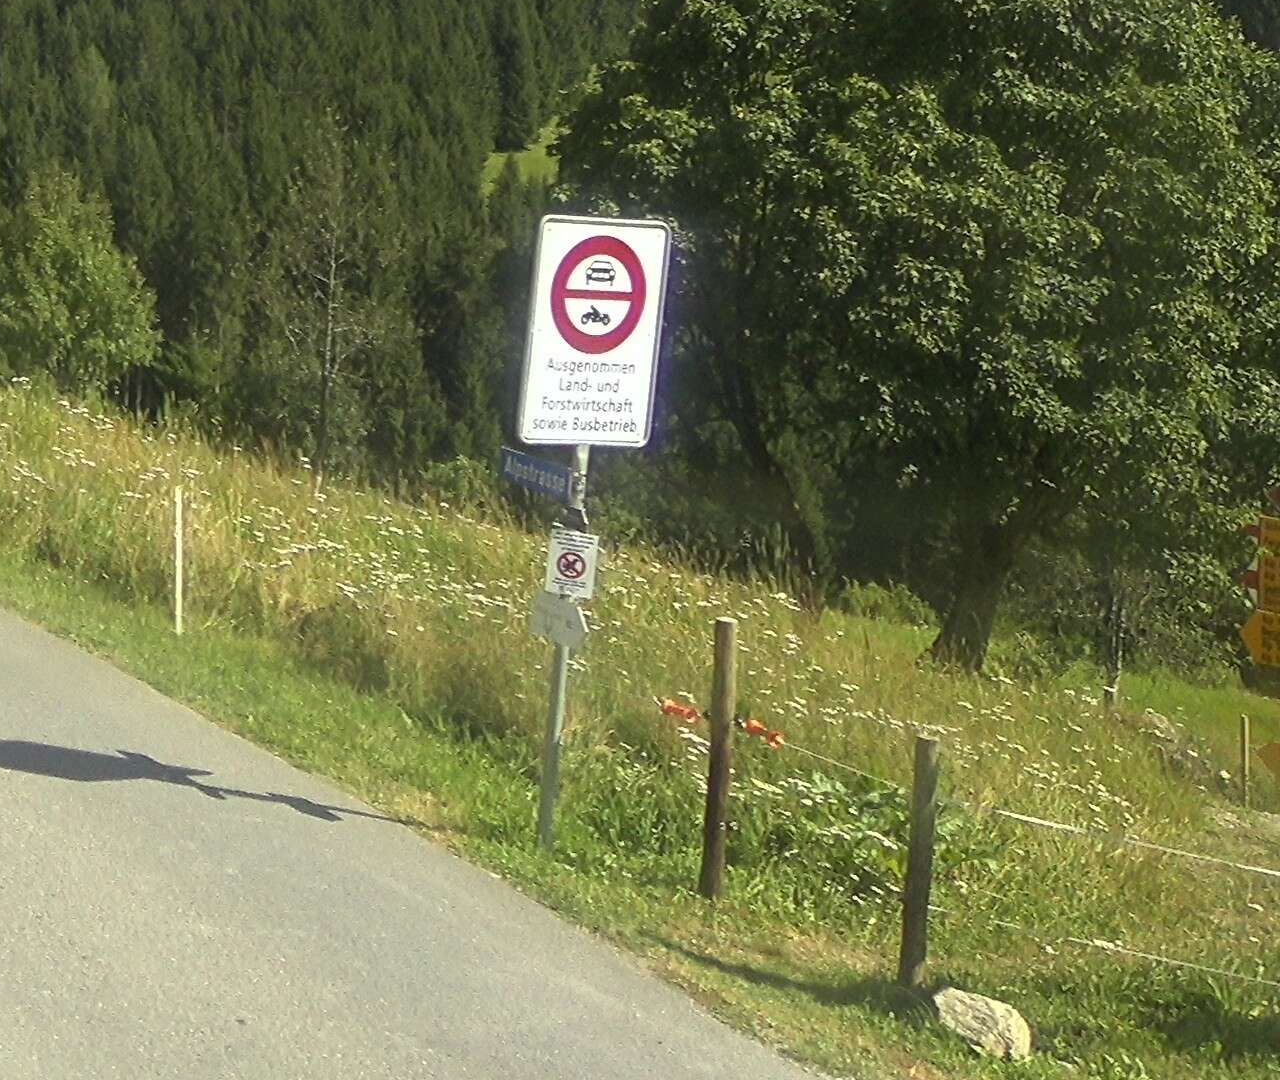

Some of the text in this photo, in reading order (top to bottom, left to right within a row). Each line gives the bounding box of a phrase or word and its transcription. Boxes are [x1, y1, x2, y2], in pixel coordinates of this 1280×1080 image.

[547, 358, 636, 376] Ausgenommen
[559, 378, 620, 393] Land- und
[542, 396, 633, 413] Forstwirtschaft
[532, 416, 637, 433] sowie Busbetrieb
